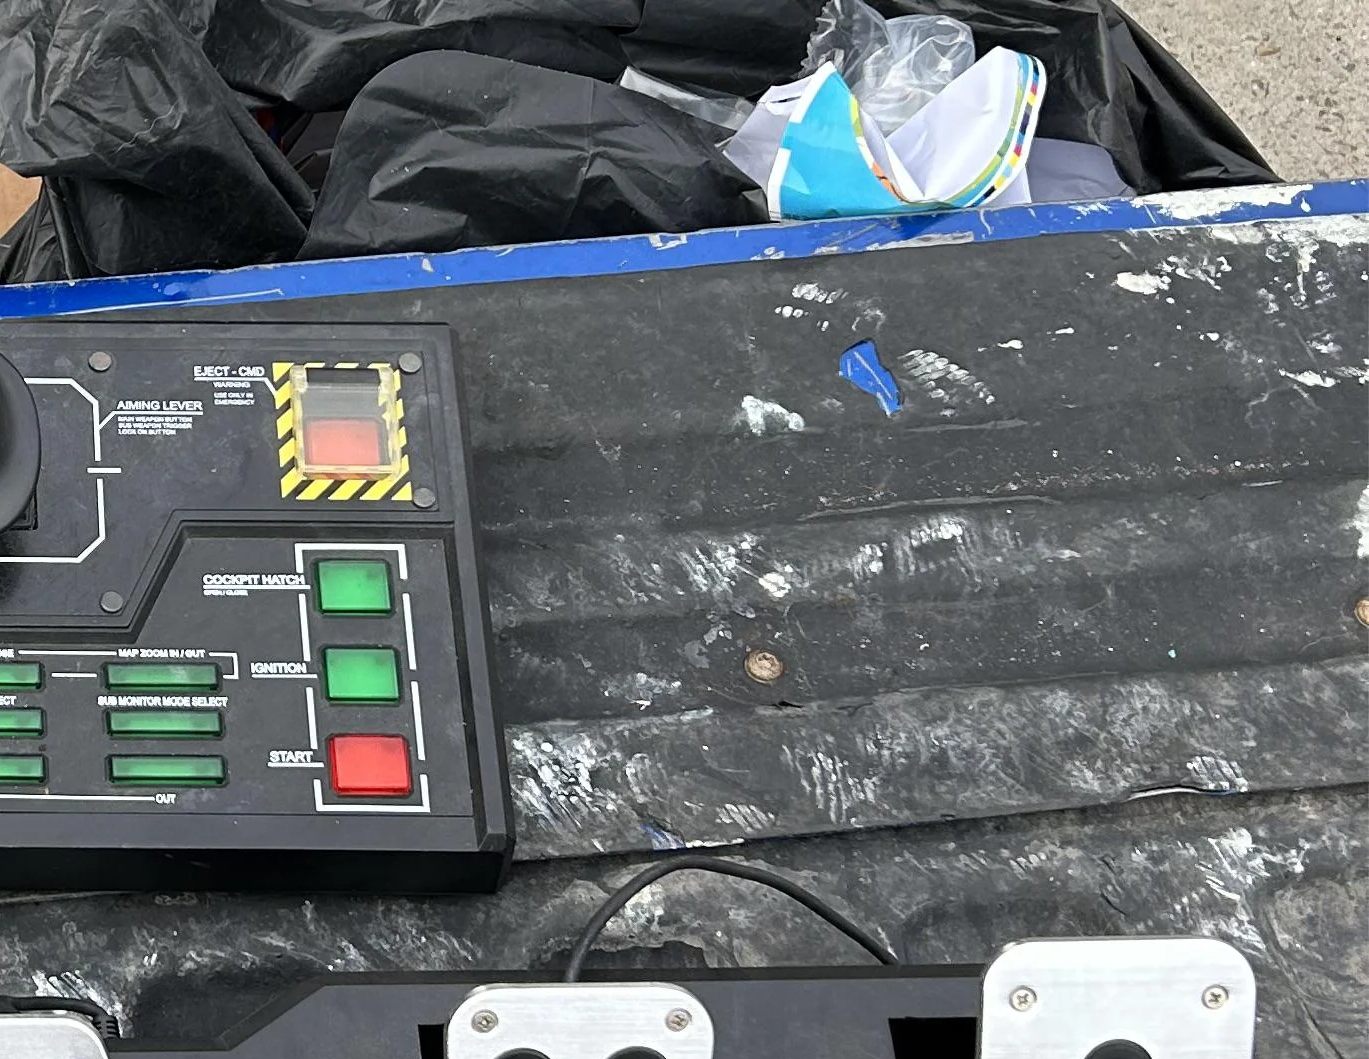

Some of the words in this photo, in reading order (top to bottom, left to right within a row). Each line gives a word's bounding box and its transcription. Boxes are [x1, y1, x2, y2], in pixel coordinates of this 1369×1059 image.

[193, 366, 230, 377] EJECT
[238, 366, 265, 377] CMD
[116, 400, 160, 410] AIMING
[162, 400, 203, 411] LEVER
[202, 574, 260, 585] COCKPIT
[261, 574, 306, 585] HATCH
[118, 648, 139, 657] MAP
[139, 648, 169, 658] ZOOM
[185, 649, 206, 658] OUT
[250, 662, 307, 674] IGNITION
[97, 695, 117, 706] SUB
[118, 695, 162, 706] MONITOR
[162, 696, 190, 706] MODE
[191, 696, 228, 707] SELECT
[269, 750, 314, 763] START
[155, 793, 177, 804] OUT
